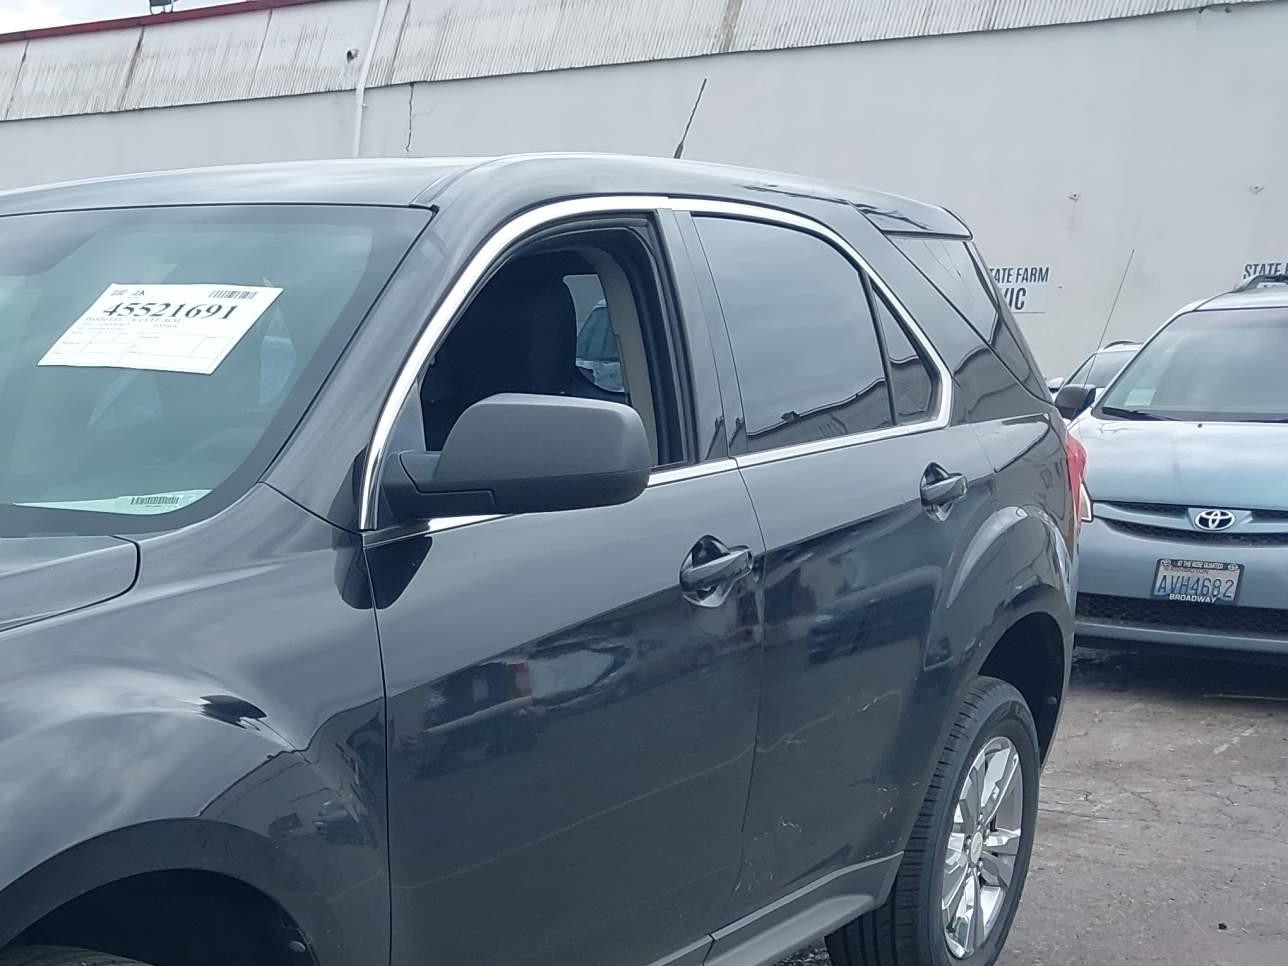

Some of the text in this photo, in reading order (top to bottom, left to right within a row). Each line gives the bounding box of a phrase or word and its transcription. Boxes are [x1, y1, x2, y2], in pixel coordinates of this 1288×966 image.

[1015, 266, 1050, 284] FARM
[103, 301, 239, 320] 45521691
[1157, 574, 1235, 599] AVH4682
[1169, 593, 1218, 604] BROADWAY
